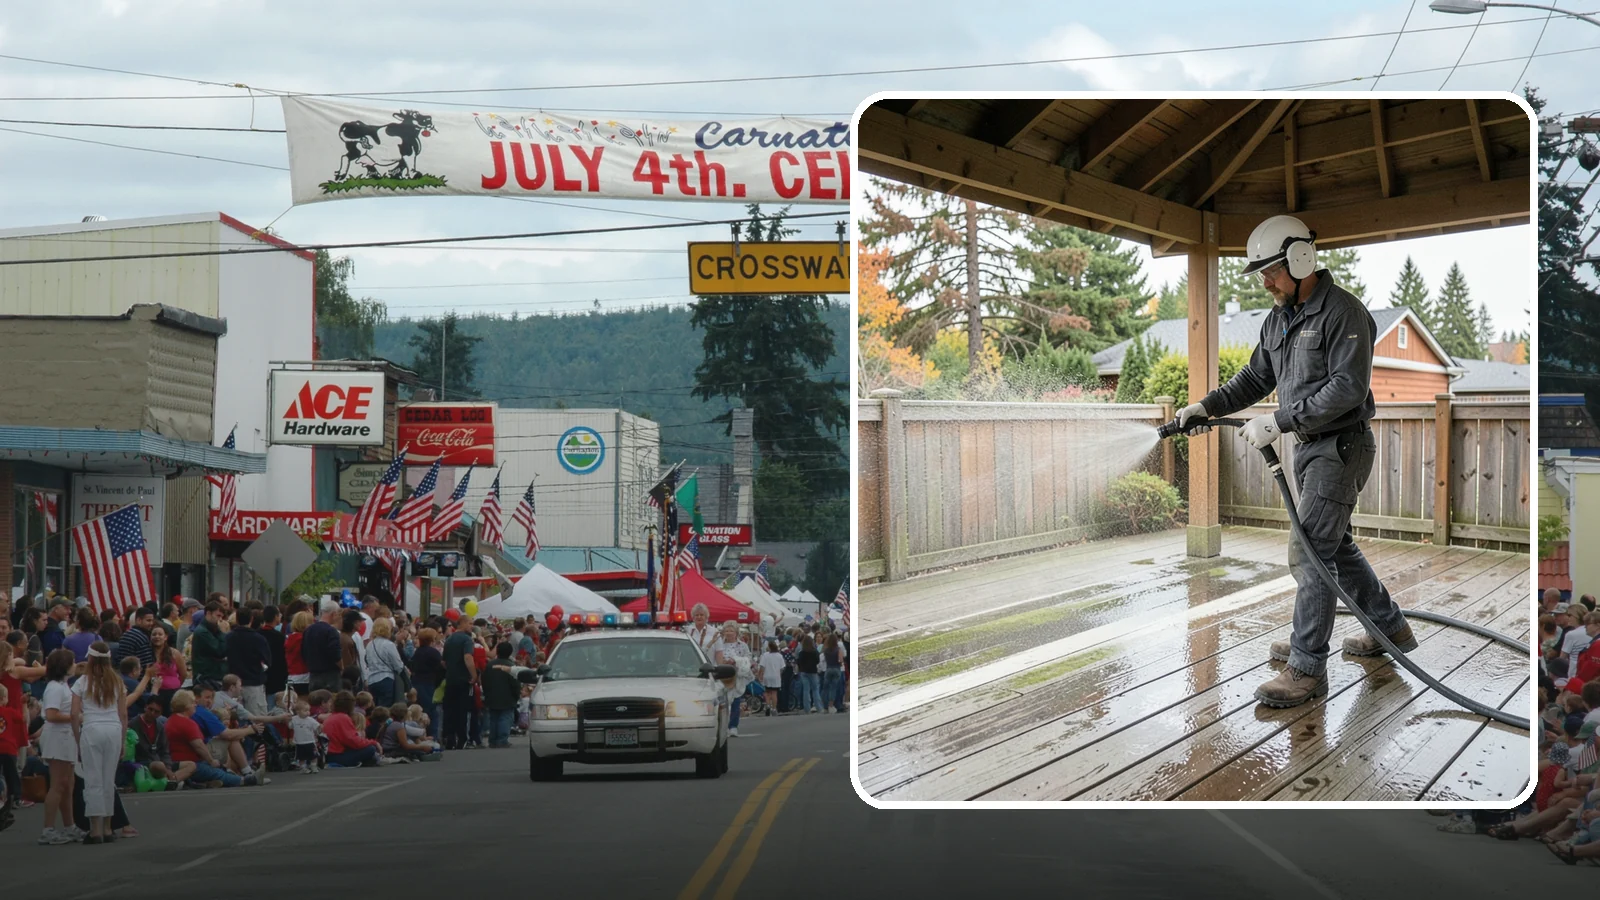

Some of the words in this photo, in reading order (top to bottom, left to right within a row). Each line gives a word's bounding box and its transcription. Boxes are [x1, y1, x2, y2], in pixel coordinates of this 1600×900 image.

[695, 121, 850, 150] Carnat
[481, 141, 605, 192] JULY
[632, 150, 747, 198] 4th.
[697, 254, 850, 280] CROSSWA
[283, 380, 374, 420] ACE
[405, 409, 453, 422] CEDAR
[283, 421, 371, 437] Hardware
[353, 467, 384, 481] Simpl
[83, 485, 94, 494] St.
[95, 485, 124, 495] Vincent
[126, 486, 136, 495] de
[138, 486, 155, 495] Paul
[687, 526, 741, 535] CRNATION
[699, 535, 730, 543] GLASS
